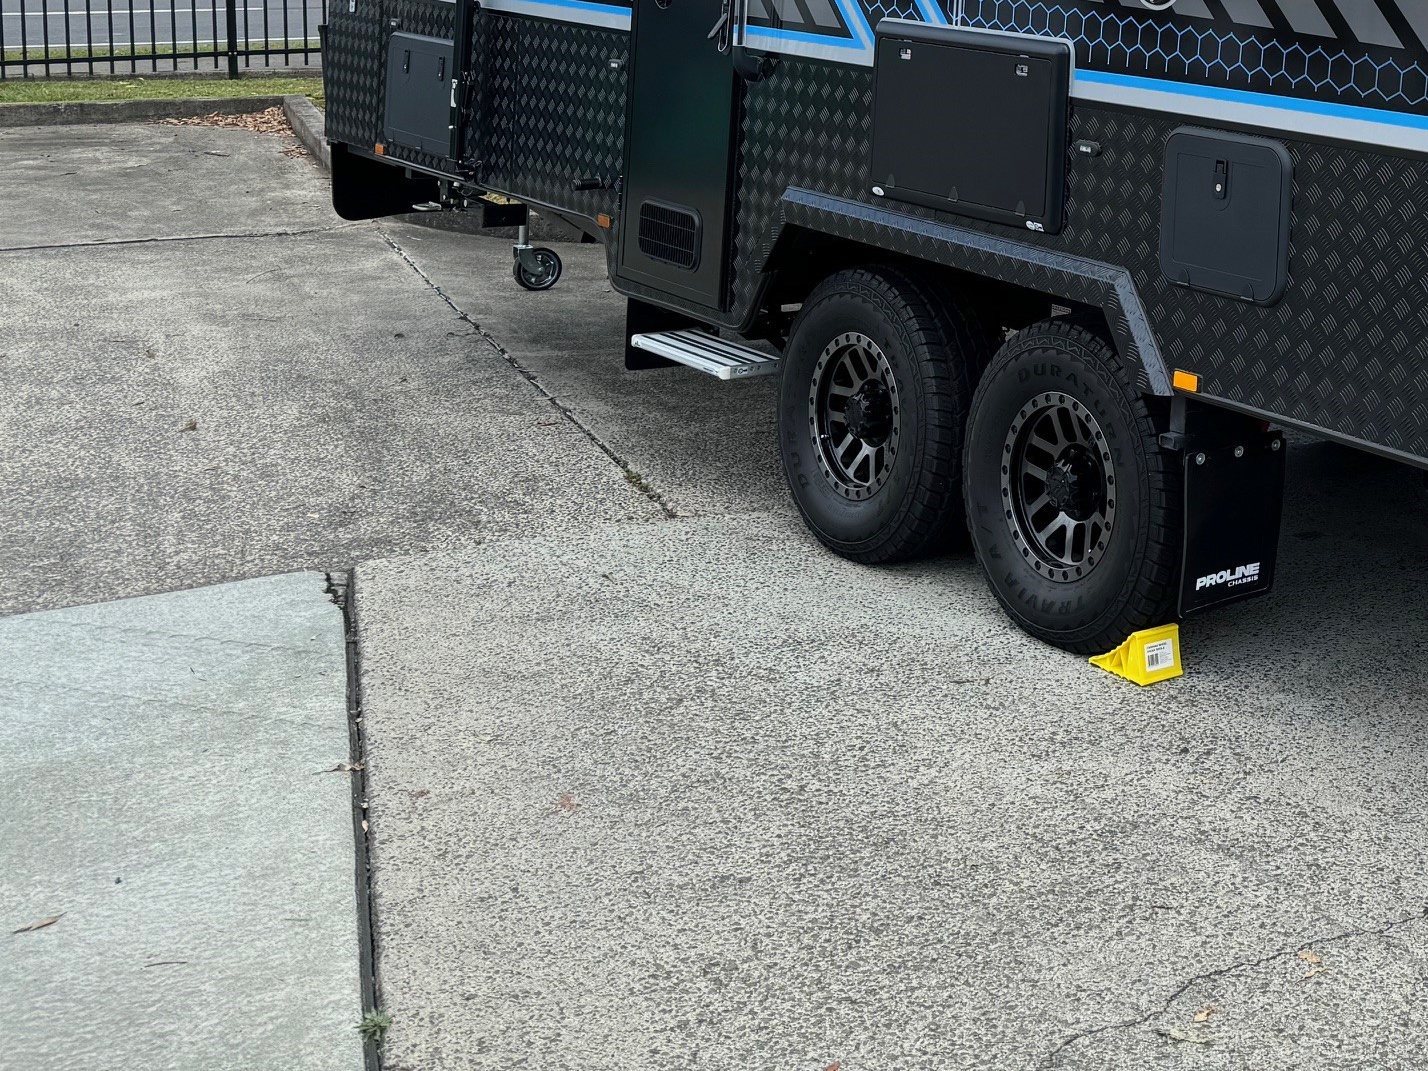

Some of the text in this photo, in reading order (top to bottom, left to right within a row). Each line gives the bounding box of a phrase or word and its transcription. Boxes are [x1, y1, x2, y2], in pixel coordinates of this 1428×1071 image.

[1017, 362, 1125, 467] DURATURN
[1196, 562, 1260, 590] PROLINE
[1228, 575, 1259, 587] CHASSIS
